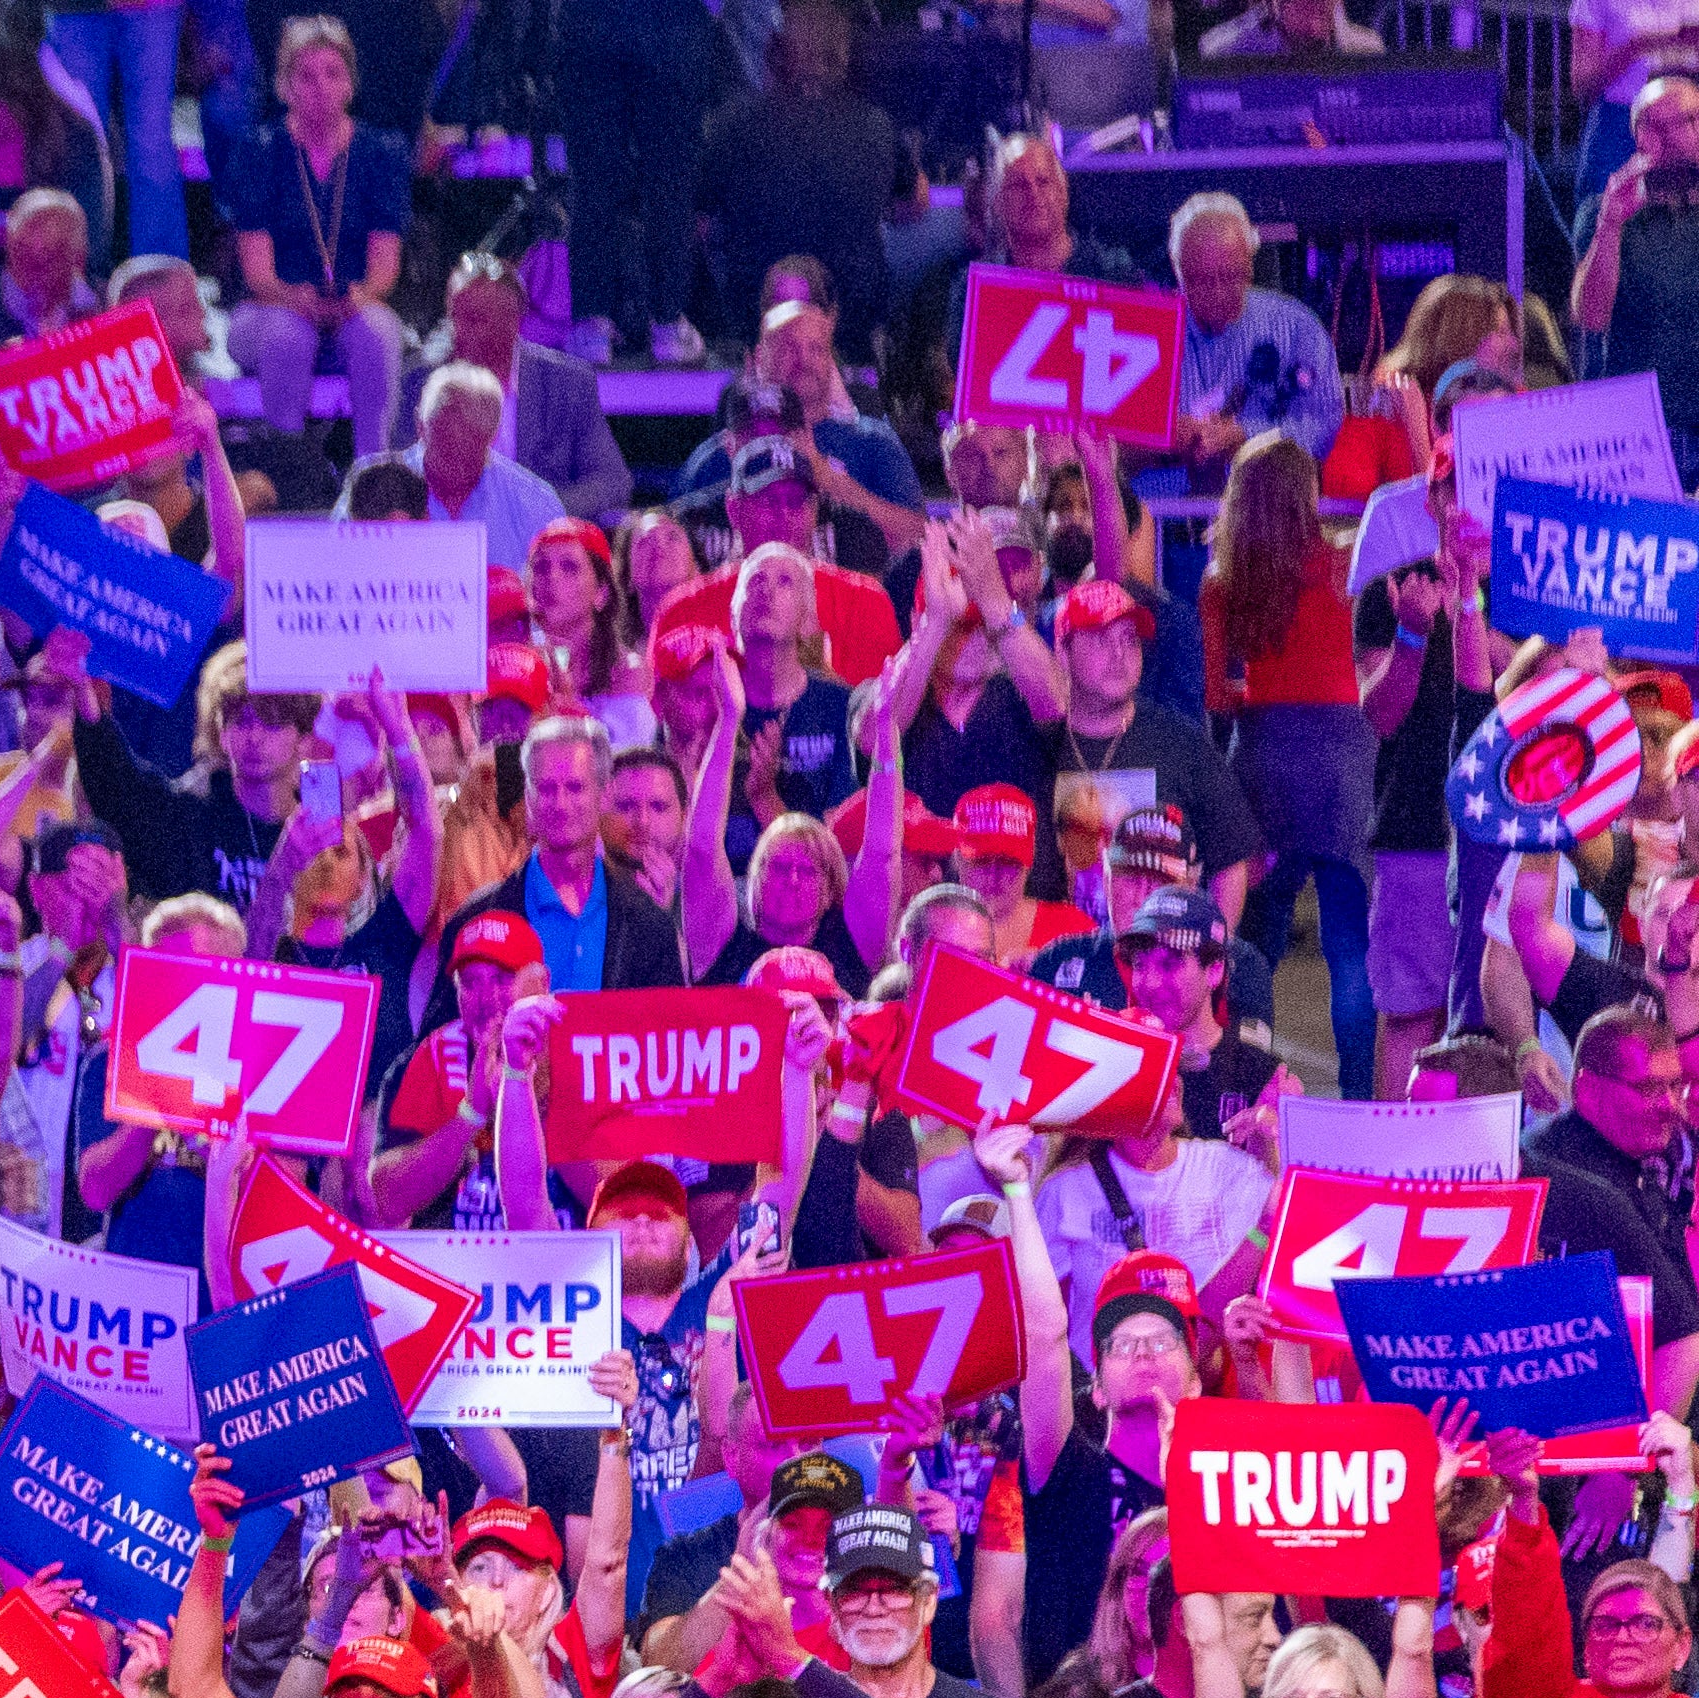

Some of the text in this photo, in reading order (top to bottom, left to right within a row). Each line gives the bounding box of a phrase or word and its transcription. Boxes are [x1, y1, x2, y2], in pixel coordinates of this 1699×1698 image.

[990, 302, 1160, 416] 47
[1504, 514, 1698, 575] TRUMP
[18, 524, 192, 645] MAKE AMERICA
[263, 579, 469, 604] MAKE AMERICA
[1523, 557, 1672, 604] VANCE
[85, 602, 170, 659] AGAIN
[277, 607, 456, 635] GREAT AGAIN
[136, 983, 345, 1116] 47
[572, 1025, 762, 1104] TRUMP
[932, 995, 1144, 1128] 47
[1292, 1202, 1512, 1292] 47
[0, 1265, 177, 1350] TRUMP
[471, 1282, 601, 1324] UMP
[14, 1315, 151, 1383] VANCE
[461, 1326, 573, 1360] NCE
[779, 1272, 986, 1406] 47
[1365, 1314, 1612, 1360] MAKE AMERICA
[205, 1334, 371, 1418] MAKE AMERICA
[486, 1364, 531, 1376] GREAT
[1389, 1348, 1600, 1392] GREAT AGAIN
[219, 1372, 369, 1449] GREAT AGAIN
[457, 1406, 502, 1418] 2024
[11, 1436, 104, 1508] MAKE
[301, 1464, 338, 1489] 2024
[1190, 1448, 1407, 1527] TRUMP
[11, 1476, 196, 1593] GREAT AGAI
[864, 1509, 912, 1535] AMERICA
[873, 1530, 910, 1553] AGAIN
